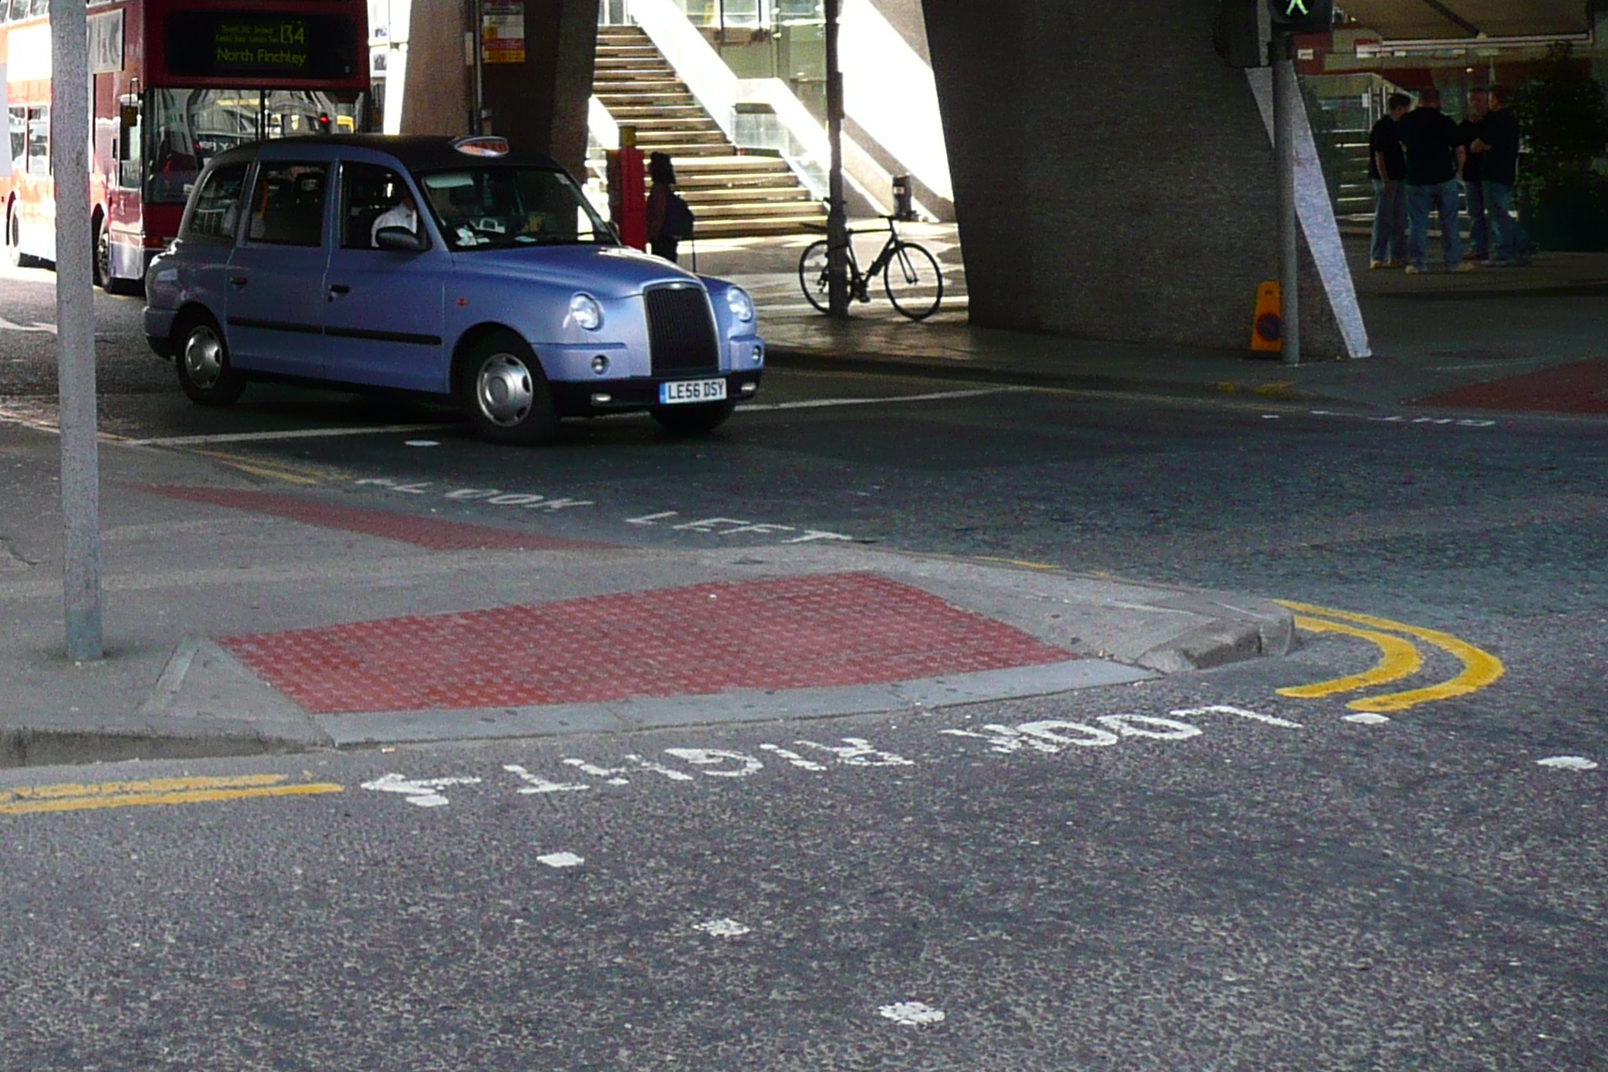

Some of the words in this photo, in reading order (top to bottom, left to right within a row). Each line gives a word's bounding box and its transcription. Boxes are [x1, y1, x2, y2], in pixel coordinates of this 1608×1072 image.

[280, 24, 305, 44] 134
[216, 47, 253, 63] North
[257, 48, 307, 67] Finchley
[668, 383, 701, 400] LE56
[703, 380, 724, 398] DSY
[391, 482, 595, 513] LOOK
[625, 511, 854, 544] LEFT
[941, 704, 1304, 754] LOOK
[502, 736, 913, 794] RIGHT
